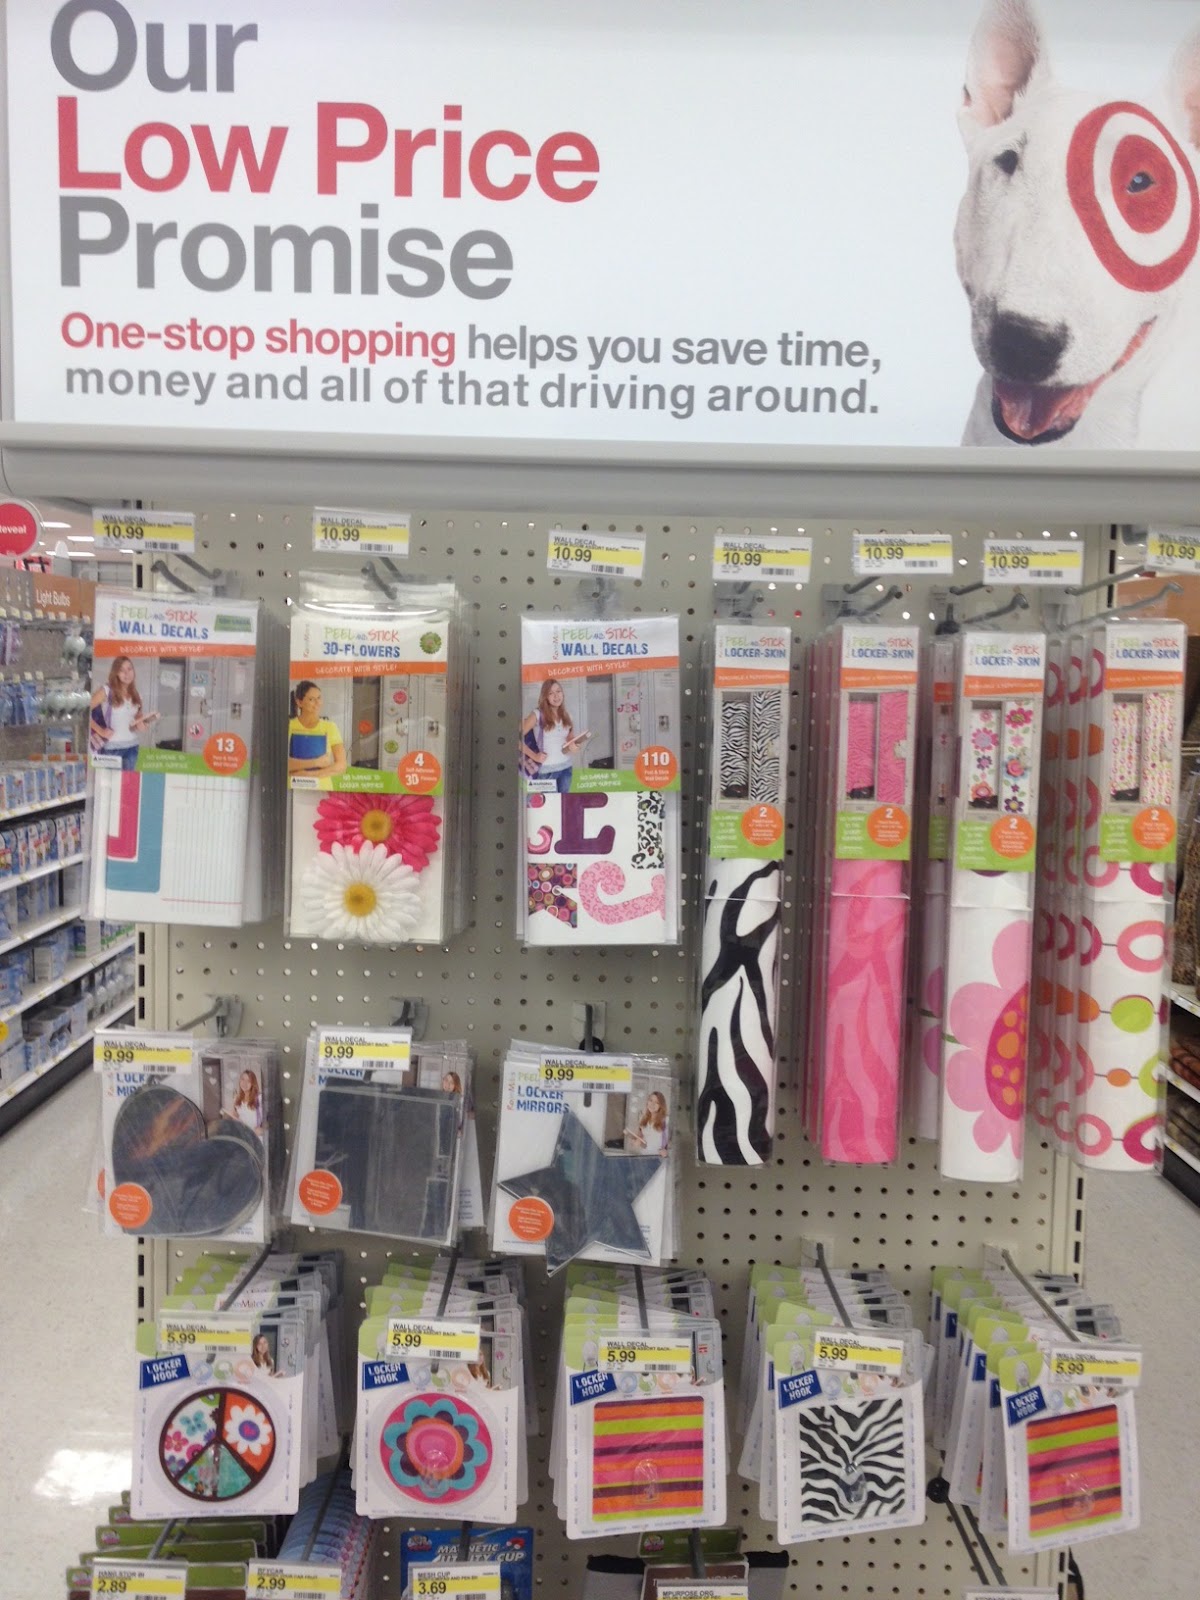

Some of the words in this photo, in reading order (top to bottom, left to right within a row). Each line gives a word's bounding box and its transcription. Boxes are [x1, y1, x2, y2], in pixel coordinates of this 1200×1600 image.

[50, 0, 258, 93] Our
[57, 96, 289, 194] Low
[317, 102, 600, 203] Price
[59, 195, 514, 300] Promise
[61, 311, 255, 360] One-stop
[265, 319, 456, 367] shopping
[468, 324, 578, 369] helps
[588, 335, 661, 371] you
[672, 335, 767, 366] save
[777, 331, 881, 374] time,
[66, 367, 216, 405] money
[226, 366, 308, 400] and
[320, 367, 371, 402] all
[384, 370, 428, 404] of
[438, 371, 529, 407] that
[540, 373, 695, 419] driving
[707, 379, 879, 414] around.
[103, 526, 145, 539] 10.99
[321, 527, 360, 541] 10.99
[554, 546, 592, 562] 10.99
[865, 547, 904, 560] 10.99
[1158, 543, 1196, 560] 10.99
[723, 552, 762, 566] 10.99
[990, 555, 1029, 568] 10.99
[36, 590, 51, 608] Light
[52, 591, 71, 607] Bulbs
[165, 609, 198, 623] STICK
[119, 620, 157, 636] WALL
[161, 623, 209, 640] DECALS
[324, 626, 356, 640] PEEL
[368, 629, 400, 642] STICK
[562, 627, 593, 641] PEEL
[605, 627, 638, 641] STICK
[561, 642, 598, 656] WALL
[602, 642, 649, 656] DECALS
[760, 637, 785, 647] STICK
[887, 637, 912, 647] STICK
[1152, 637, 1178, 648] STICK
[323, 642, 401, 658] 3D-FLOWERS
[724, 648, 786, 659] LOCKER-SKIN
[851, 648, 914, 659] LOCKER-SKIN
[1012, 644, 1040, 655] STICK
[1116, 648, 1180, 659] LOCKER-SKIN
[975, 655, 1041, 667] LOCKER-SKIN
[548, 665, 584, 677] DECORATE
[586, 663, 603, 672] WITH
[216, 737, 235, 752] 13
[414, 753, 425, 767] 4
[641, 751, 670, 766] 110
[405, 773, 420, 786] 3D
[759, 807, 767, 818] 2
[885, 808, 893, 819] 2
[1151, 810, 1159, 821] 2
[1010, 818, 1018, 829] 2
[104, 1050, 134, 1063] 9.99
[324, 1046, 354, 1059] 9.99
[545, 1069, 574, 1081] 9.99
[517, 1085, 564, 1100] LOCKER
[516, 1100, 570, 1114] MIRRORS
[393, 1323, 412, 1331] WALL
[413, 1324, 434, 1332] DECAL
[167, 1332, 196, 1344] 5.99
[392, 1334, 422, 1347] 5.99
[607, 1351, 636, 1363] 5.99
[819, 1346, 848, 1361] 5.99
[146, 1358, 182, 1373] LOCKER
[368, 1362, 401, 1375] LOCKER
[1056, 1362, 1085, 1375] 5.99
[153, 1369, 179, 1383] HOOK
[373, 1371, 399, 1385] HOOK
[575, 1372, 608, 1389] LOCKER
[783, 1374, 814, 1392] LOCKER
[582, 1382, 606, 1397] HOOK
[789, 1385, 812, 1400] HOOK
[437, 1543, 500, 1554] MANETIC
[496, 1552, 525, 1563] CUP
[97, 1580, 127, 1593] 2.89
[256, 1577, 286, 1590] 2.99
[418, 1581, 447, 1595] 3.69
